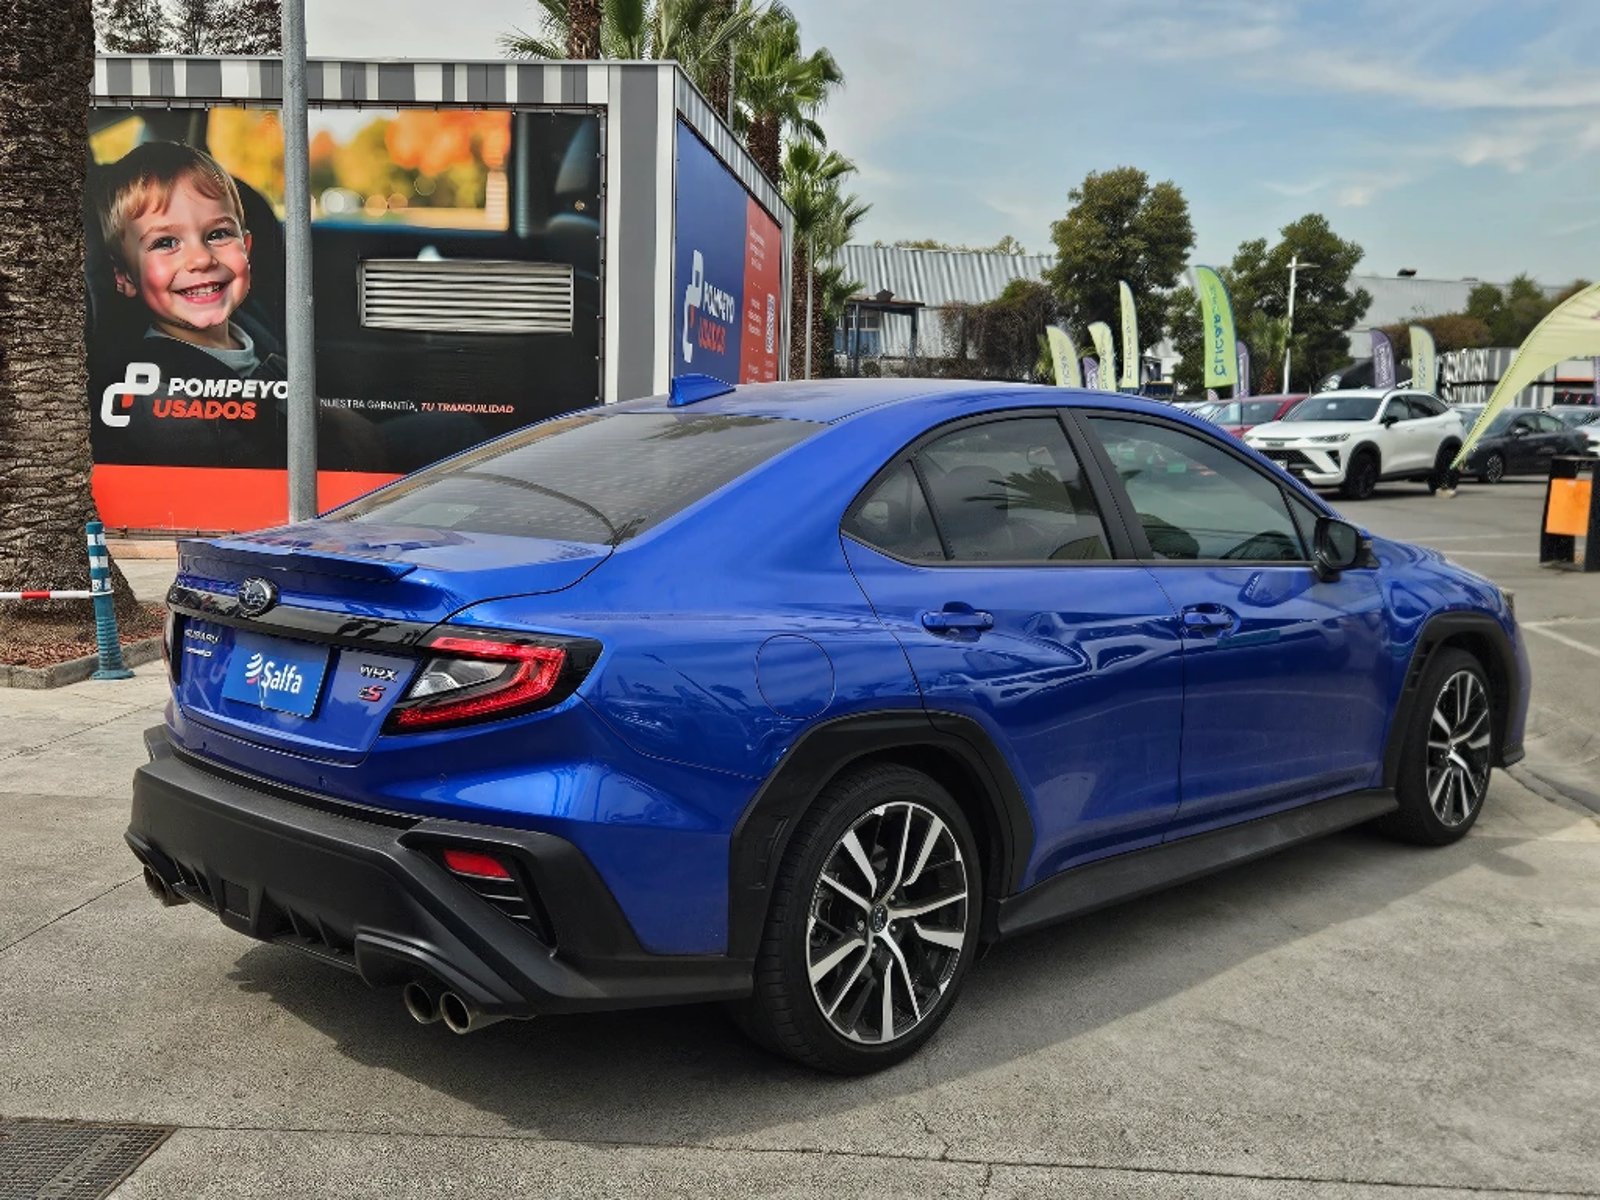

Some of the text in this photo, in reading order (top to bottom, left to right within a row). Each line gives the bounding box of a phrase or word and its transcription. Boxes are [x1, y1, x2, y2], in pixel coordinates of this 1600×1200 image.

[702, 281, 734, 324] POMPEYO
[168, 378, 288, 399] POMPEYO
[152, 400, 256, 420] USADOS
[320, 399, 365, 409] NUESTRA
[421, 402, 435, 411] TU
[437, 403, 514, 413] TRANQUILIDAD
[261, 661, 302, 694] Salfa
